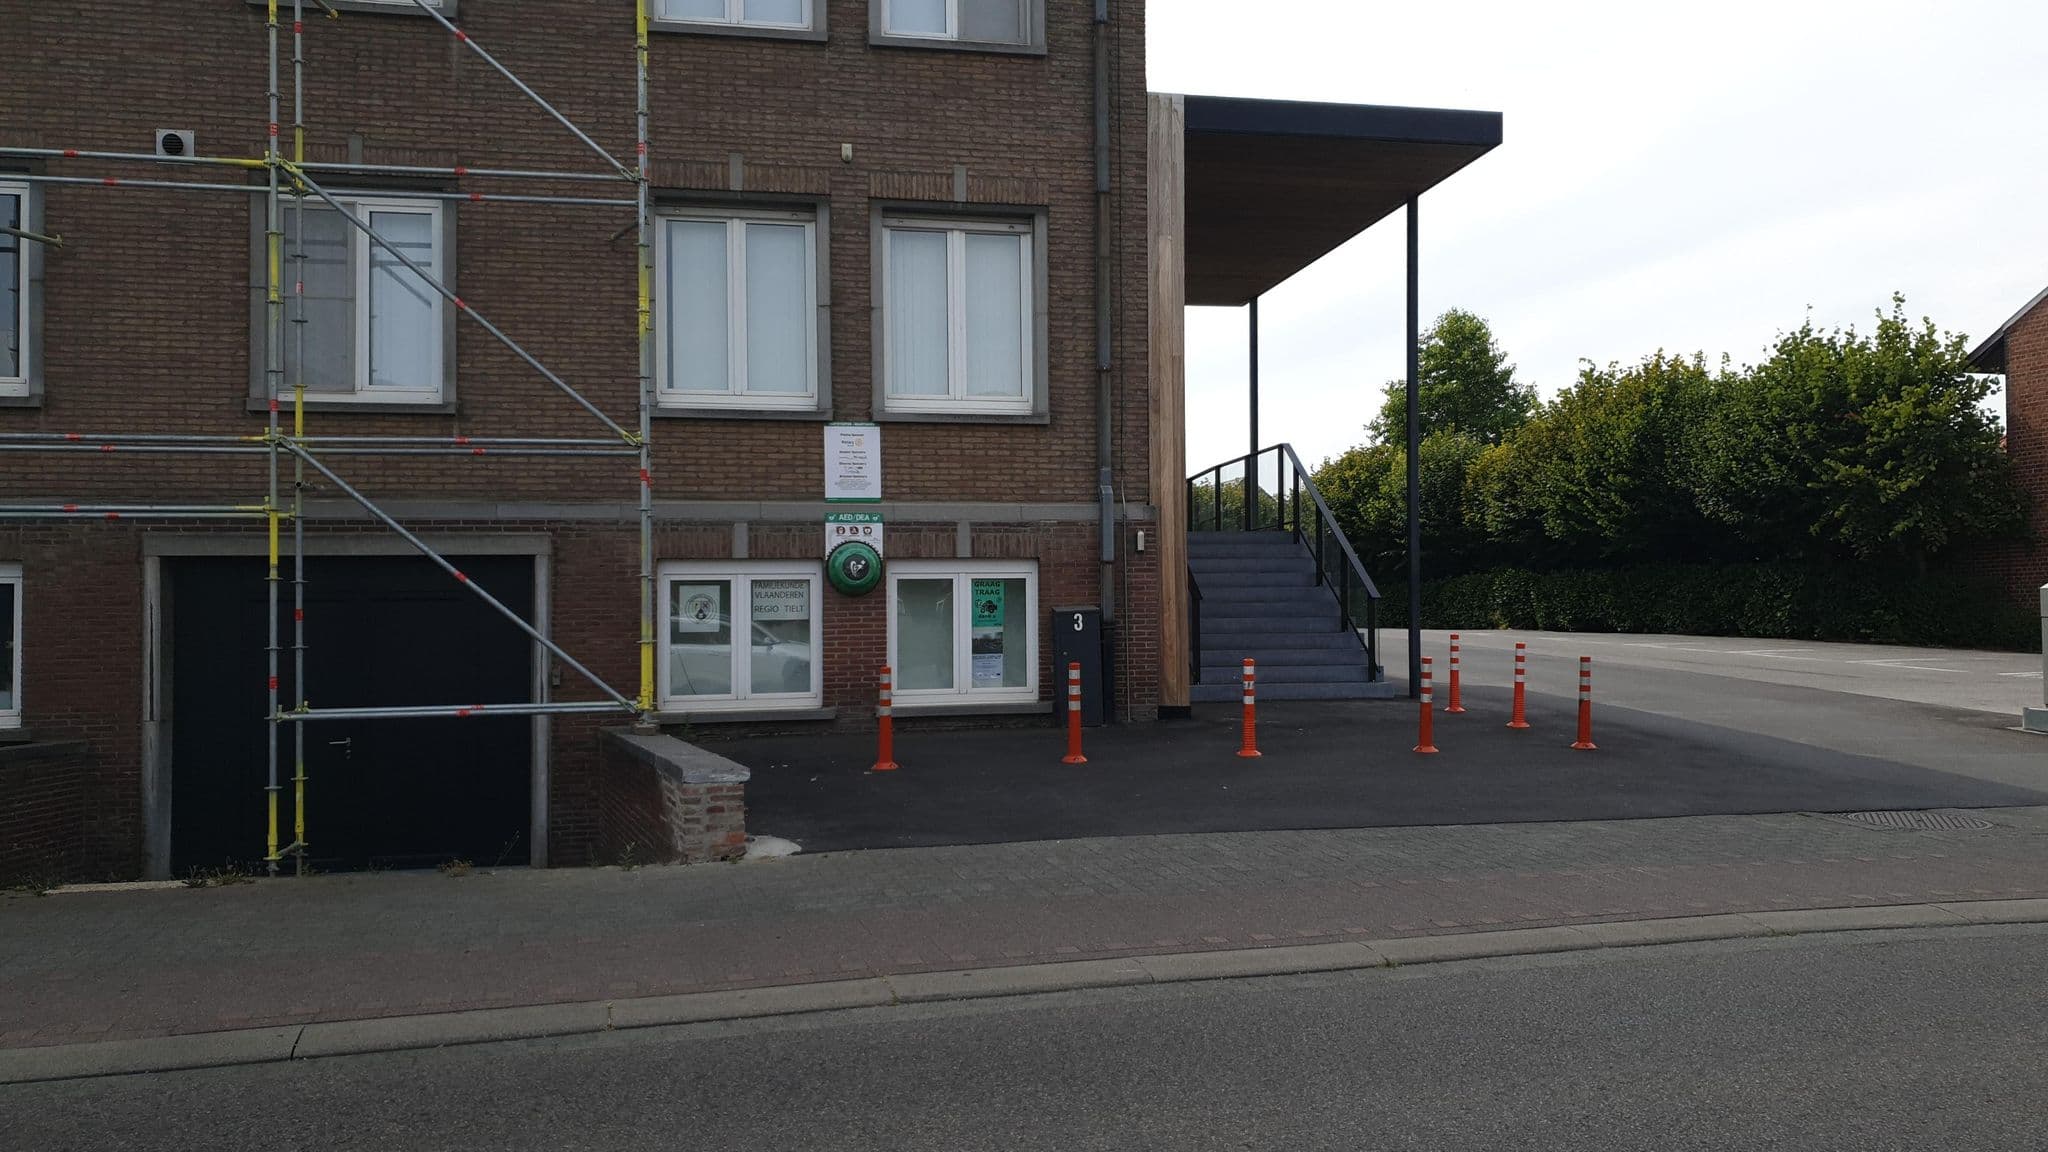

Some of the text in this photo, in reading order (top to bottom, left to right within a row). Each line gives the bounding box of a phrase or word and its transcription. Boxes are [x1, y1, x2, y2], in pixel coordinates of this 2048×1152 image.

[754, 591, 804, 599] VLAANDEREN
[754, 604, 804, 613] REGIO TIELT
[1073, 613, 1083, 631] 3
